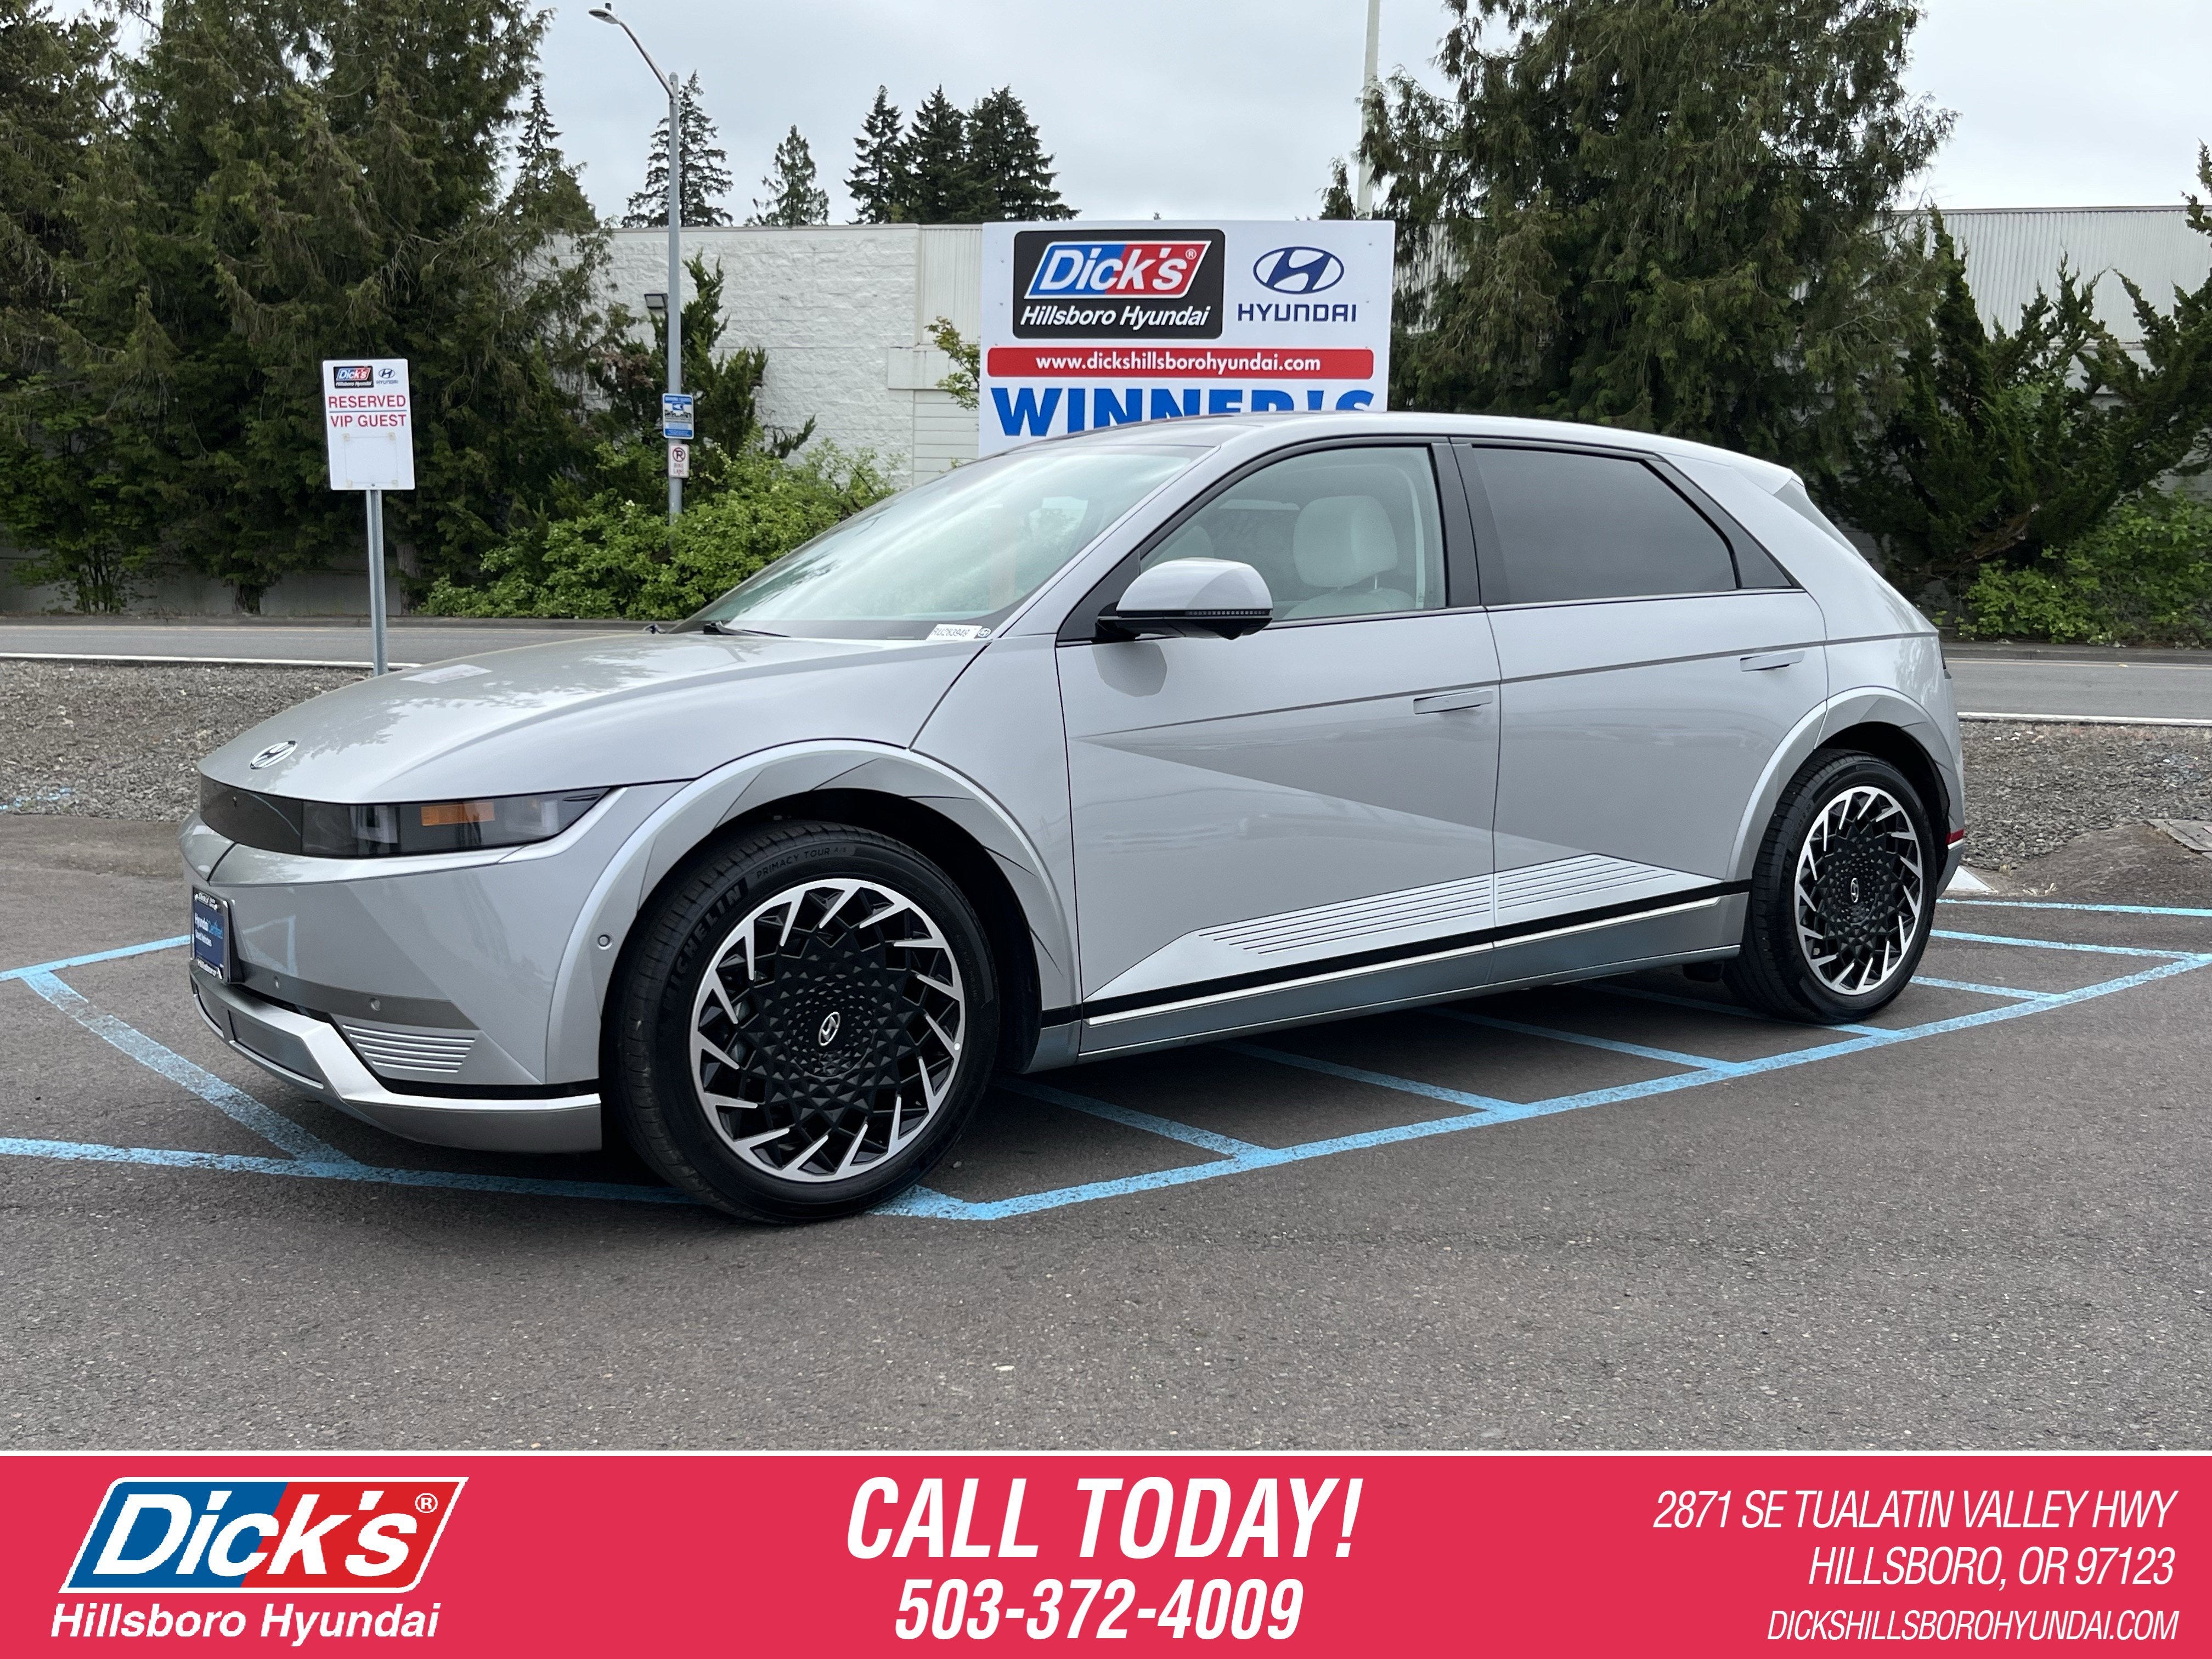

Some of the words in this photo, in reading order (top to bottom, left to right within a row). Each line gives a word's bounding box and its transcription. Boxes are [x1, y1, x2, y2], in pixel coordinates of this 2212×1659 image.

[1039, 247, 1187, 292] Dick's
[1020, 305, 1114, 326] Hillsboro
[1119, 306, 1211, 330] Hyundai
[1238, 303, 1357, 322] HYUNDAI
[1036, 351, 1321, 375] www.dickshillsborohyundai.com
[337, 368, 368, 380] Dick's
[329, 395, 407, 408] RESERVED
[330, 415, 353, 427] VIP
[358, 414, 407, 427] GUEST
[756, 854, 800, 878] PRIMACY
[804, 848, 830, 859] TOUR
